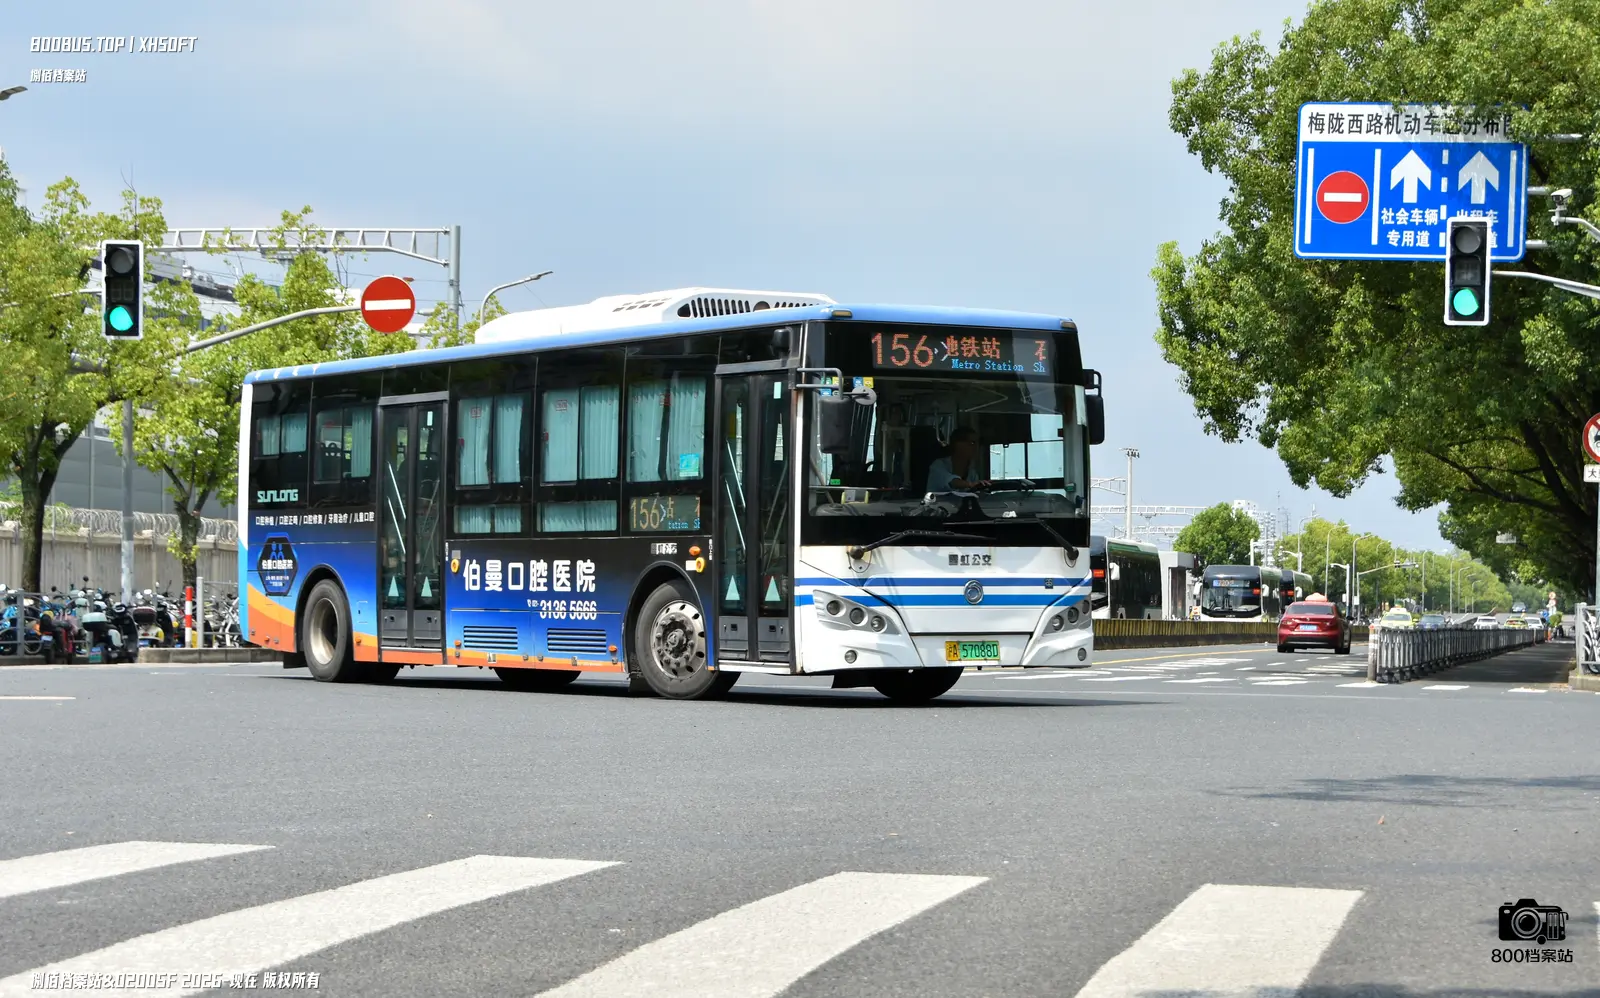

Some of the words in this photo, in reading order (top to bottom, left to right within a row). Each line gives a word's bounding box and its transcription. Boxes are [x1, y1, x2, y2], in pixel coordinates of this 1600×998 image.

[1381, 207, 1438, 225] 社会车辆
[1387, 230, 1430, 247] 专用道
[871, 332, 934, 367] 156
[945, 335, 1000, 359] 地铁站
[951, 358, 980, 370] Metro
[985, 359, 1024, 372] Station
[1588, 468, 1600, 478] 大
[257, 489, 299, 503] SUNLONG
[631, 498, 660, 529] 156
[463, 559, 596, 592] 伯曼口腔医院
[540, 599, 566, 619] 3136
[569, 600, 597, 620] 5666
